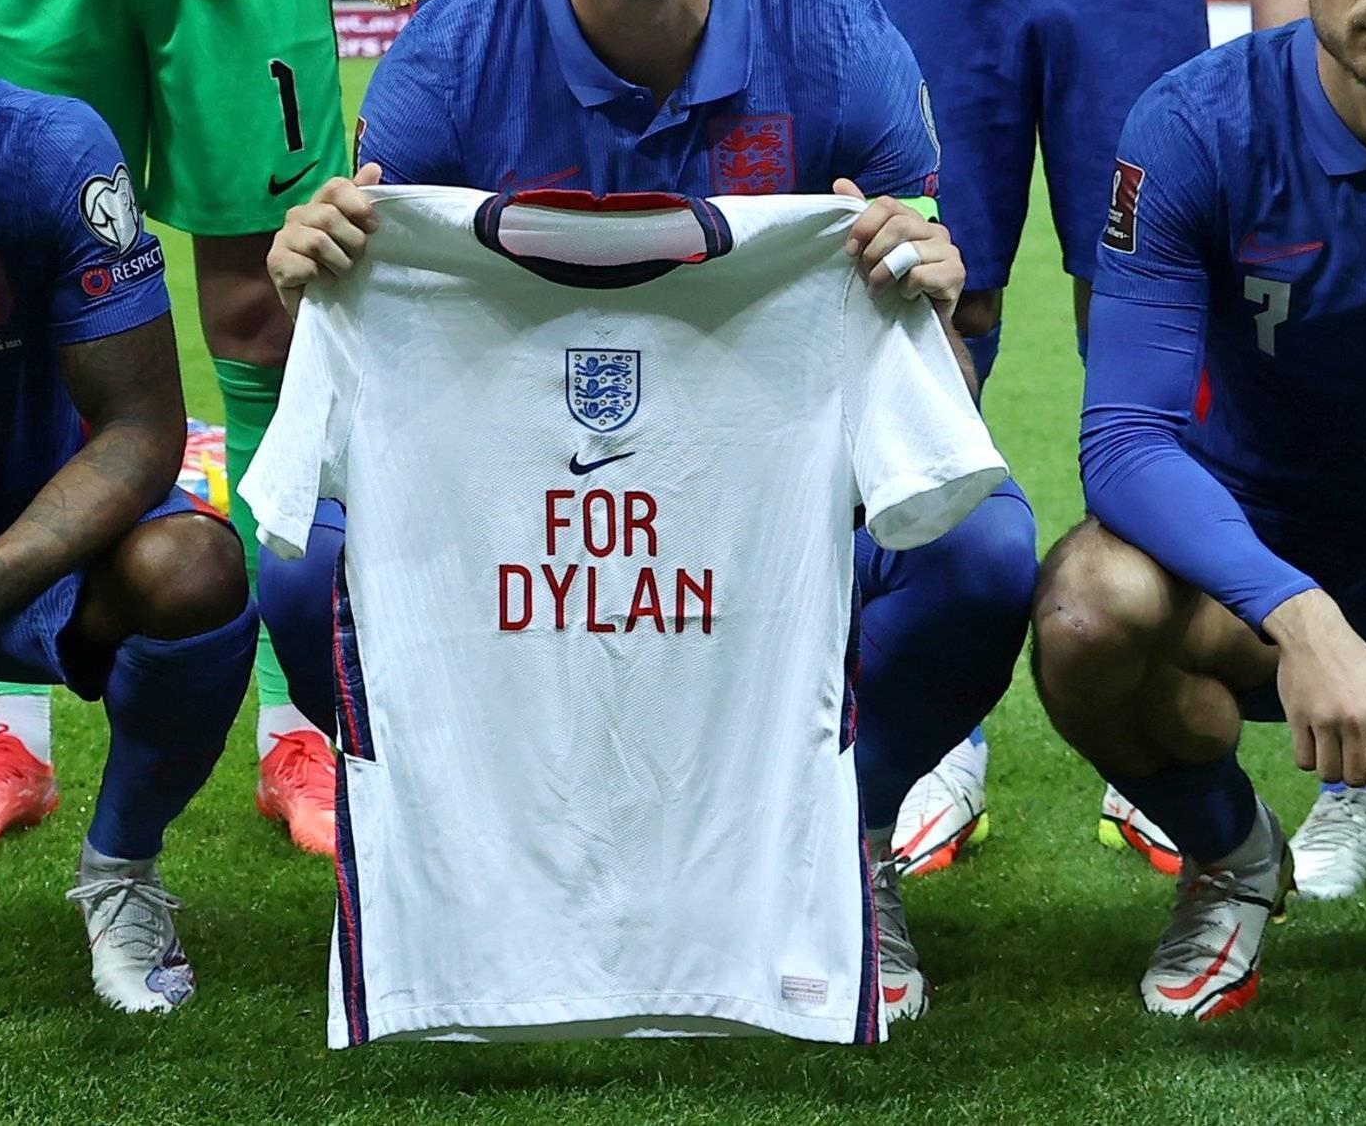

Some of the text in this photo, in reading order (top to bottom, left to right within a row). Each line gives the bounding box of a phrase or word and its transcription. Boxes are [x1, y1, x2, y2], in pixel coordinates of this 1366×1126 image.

[268, 59, 304, 153] 1
[111, 246, 163, 283] RESPECT
[1243, 276, 1292, 358] 7
[545, 488, 658, 558] FOR
[498, 563, 713, 635] DYLAN
